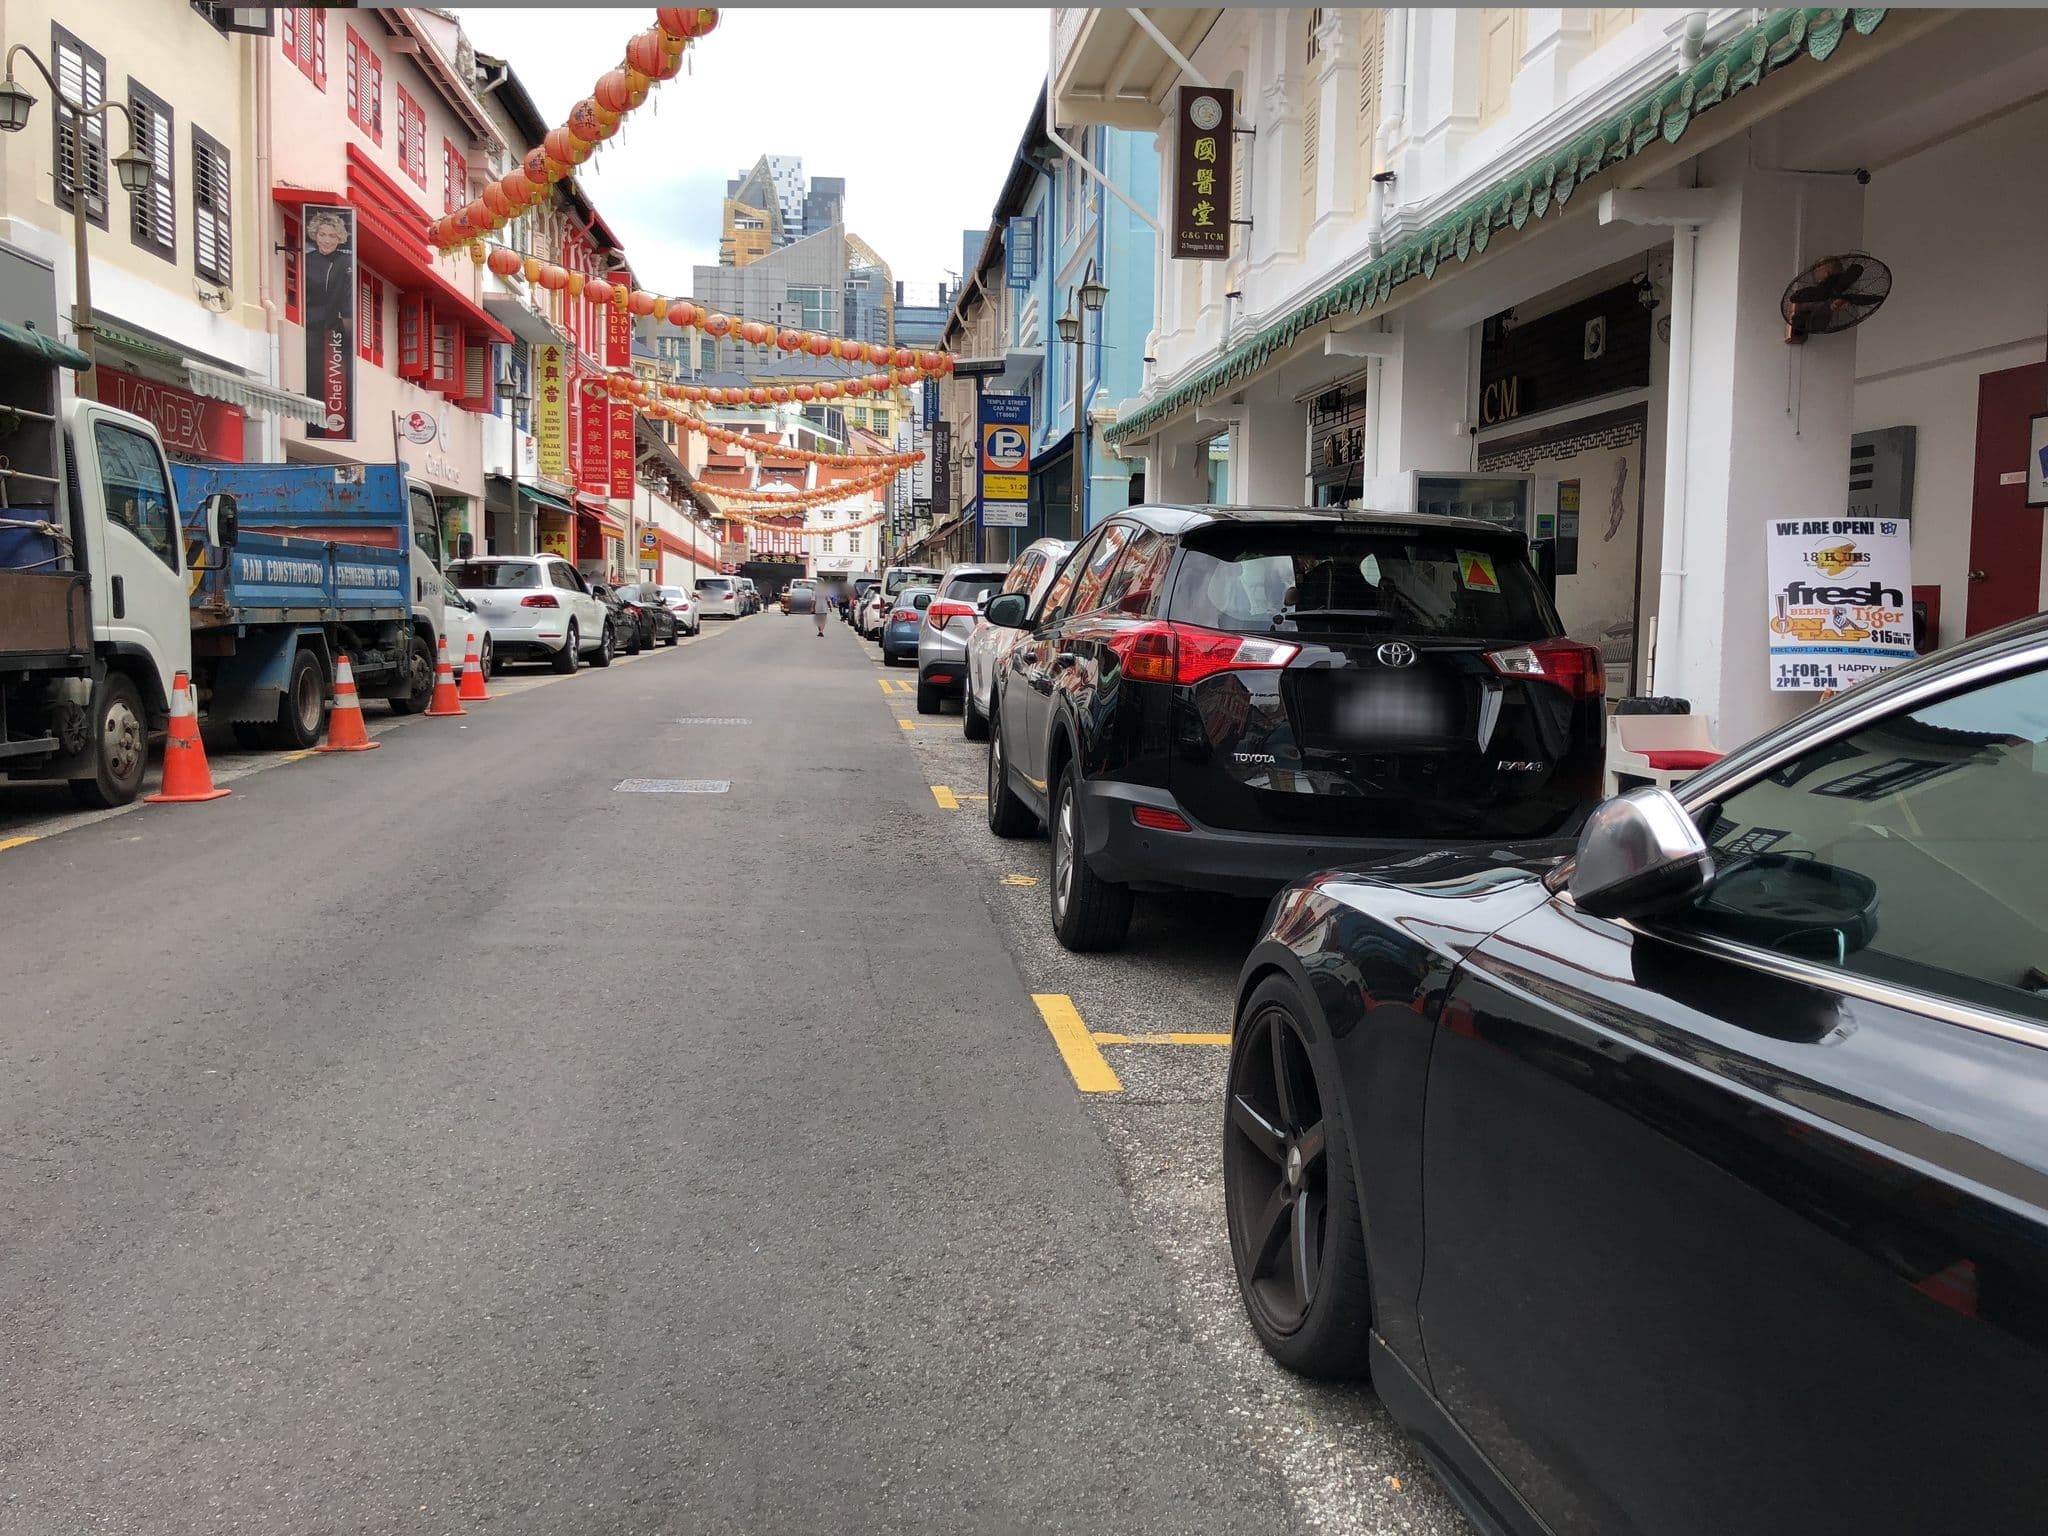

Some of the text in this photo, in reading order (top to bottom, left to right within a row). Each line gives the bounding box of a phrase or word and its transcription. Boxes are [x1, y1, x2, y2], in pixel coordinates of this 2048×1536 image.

[1181, 231, 1224, 240] G&G TCM
[610, 300, 618, 344] LDEN
[913, 411, 923, 498] KITCHNWARE
[1776, 522, 1799, 536] WE
[1802, 521, 1831, 535] ARE
[1832, 520, 1875, 535] OPEN!
[1803, 552, 1818, 562] 18
[242, 558, 263, 581] RAM
[267, 559, 323, 584] CONSTRUCTION
[337, 566, 375, 586] ENGINEERING
[377, 569, 388, 587] PTE
[389, 569, 400, 588] LTD
[1783, 581, 1904, 608] fresh
[1790, 605, 1904, 629] BEERS Tiger
[1871, 630, 1892, 644] $15
[1779, 663, 1833, 677] 1-FOR-1
[1838, 664, 1877, 673] HAPPY
[1776, 677, 1800, 688] 2PM
[1813, 677, 1838, 688] 8PM
[1233, 752, 1276, 764] TOYOTA
